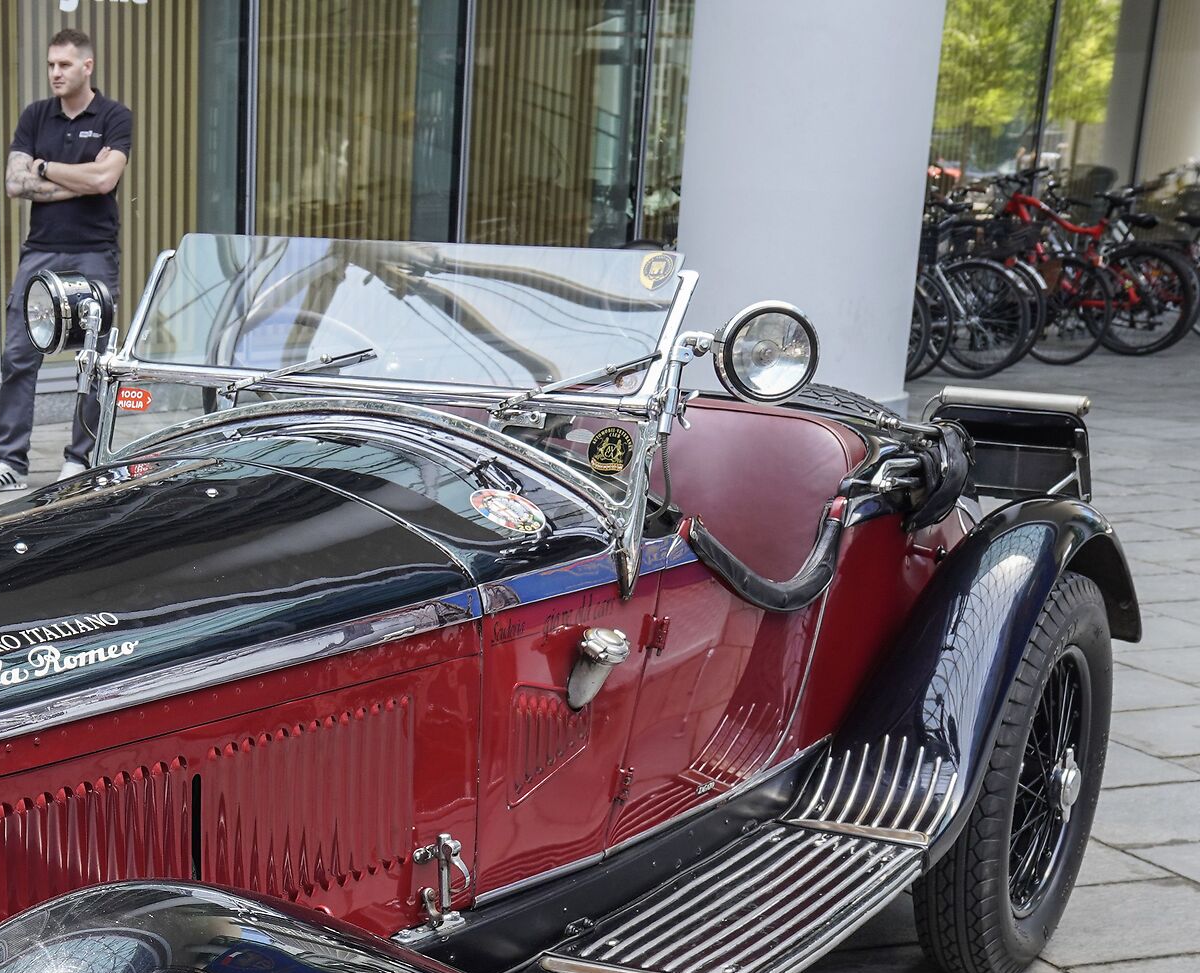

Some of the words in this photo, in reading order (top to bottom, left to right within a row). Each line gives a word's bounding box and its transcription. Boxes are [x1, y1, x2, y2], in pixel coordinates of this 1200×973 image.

[118, 400, 144, 409] MIGLIA
[120, 390, 143, 399] 1000
[19, 612, 119, 645] ITALIANO
[28, 639, 140, 678] Romeo
